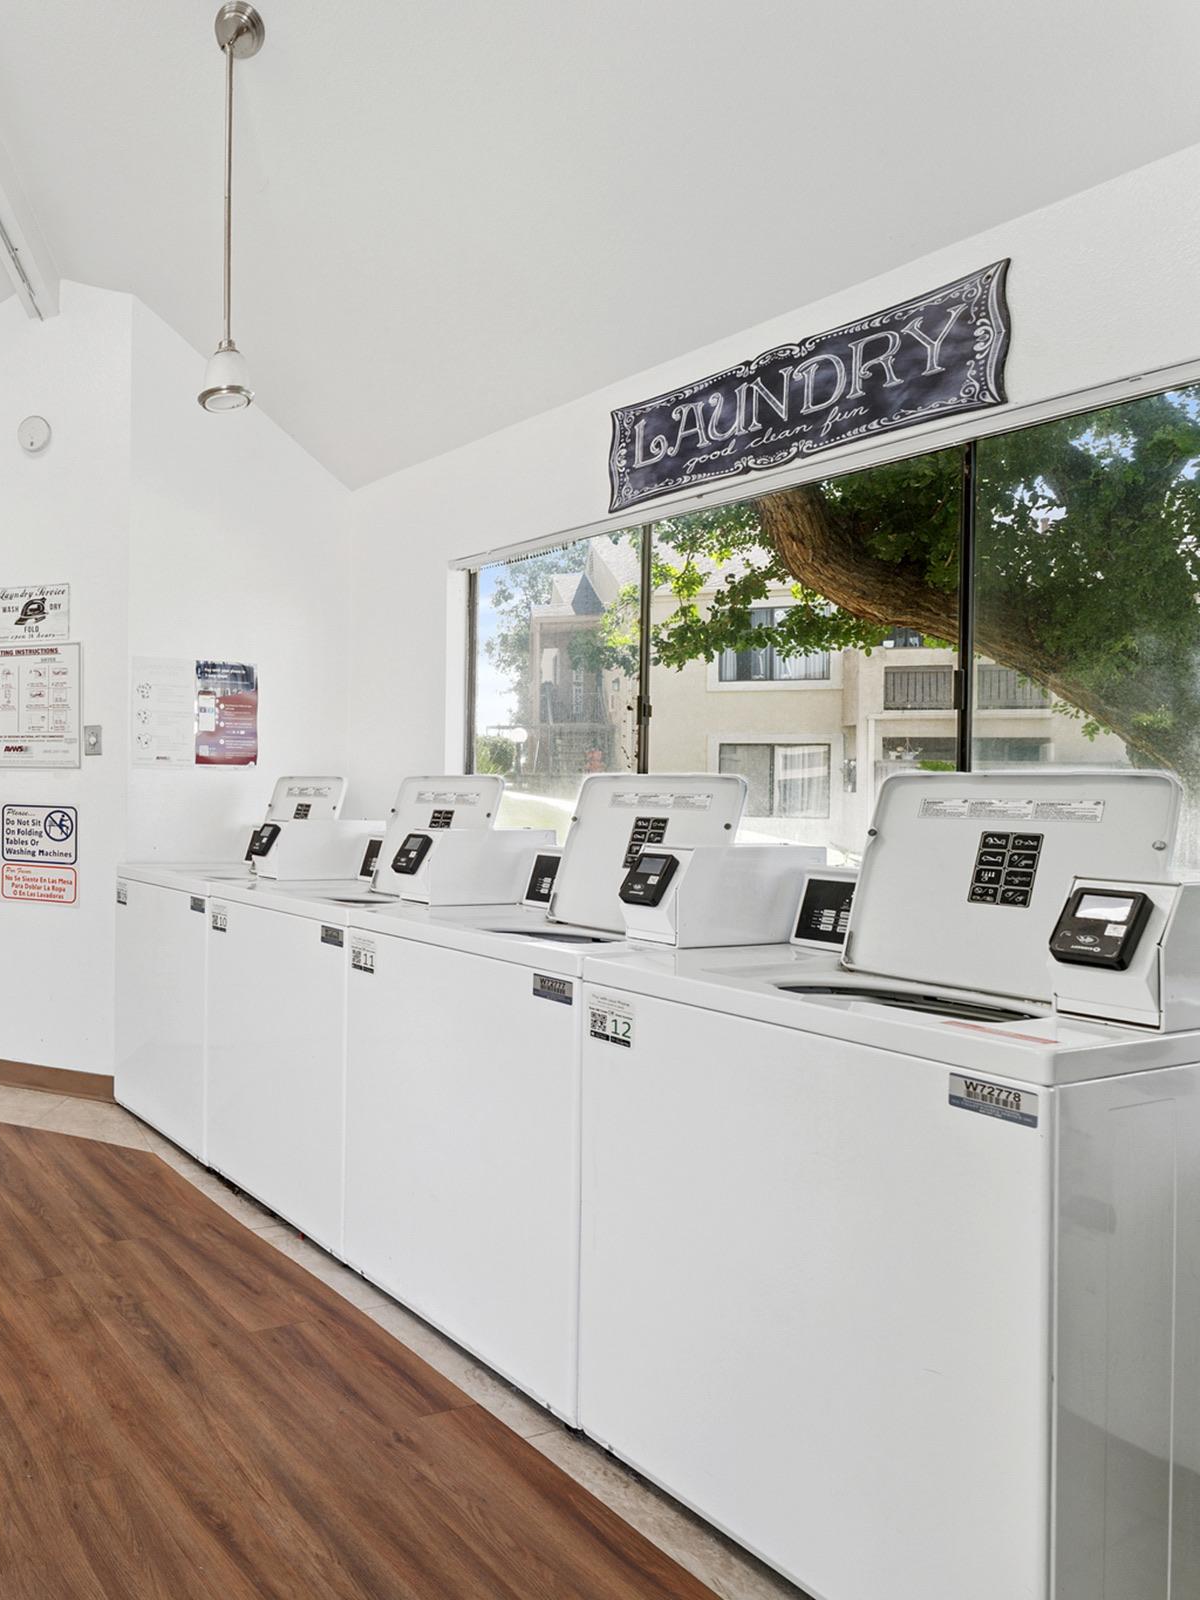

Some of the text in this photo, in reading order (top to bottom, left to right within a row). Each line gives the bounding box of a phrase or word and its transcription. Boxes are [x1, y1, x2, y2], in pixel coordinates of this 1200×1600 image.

[633, 303, 969, 468] LAUNDRY
[683, 403, 869, 471] good clean fun
[0, 589, 34, 600] Laundry
[24, 625, 39, 633] FOLD
[14, 648, 59, 656] INSTRUCTIONS
[5, 818, 41, 827] Do Not Sit
[5, 828, 43, 838] On Folding
[6, 838, 39, 846] Tables Or
[5, 847, 73, 858] Washing Machines
[219, 916, 227, 928] 10
[363, 953, 374, 967] 11
[611, 1019, 631, 1039] 12
[964, 1080, 1022, 1103] W72778
